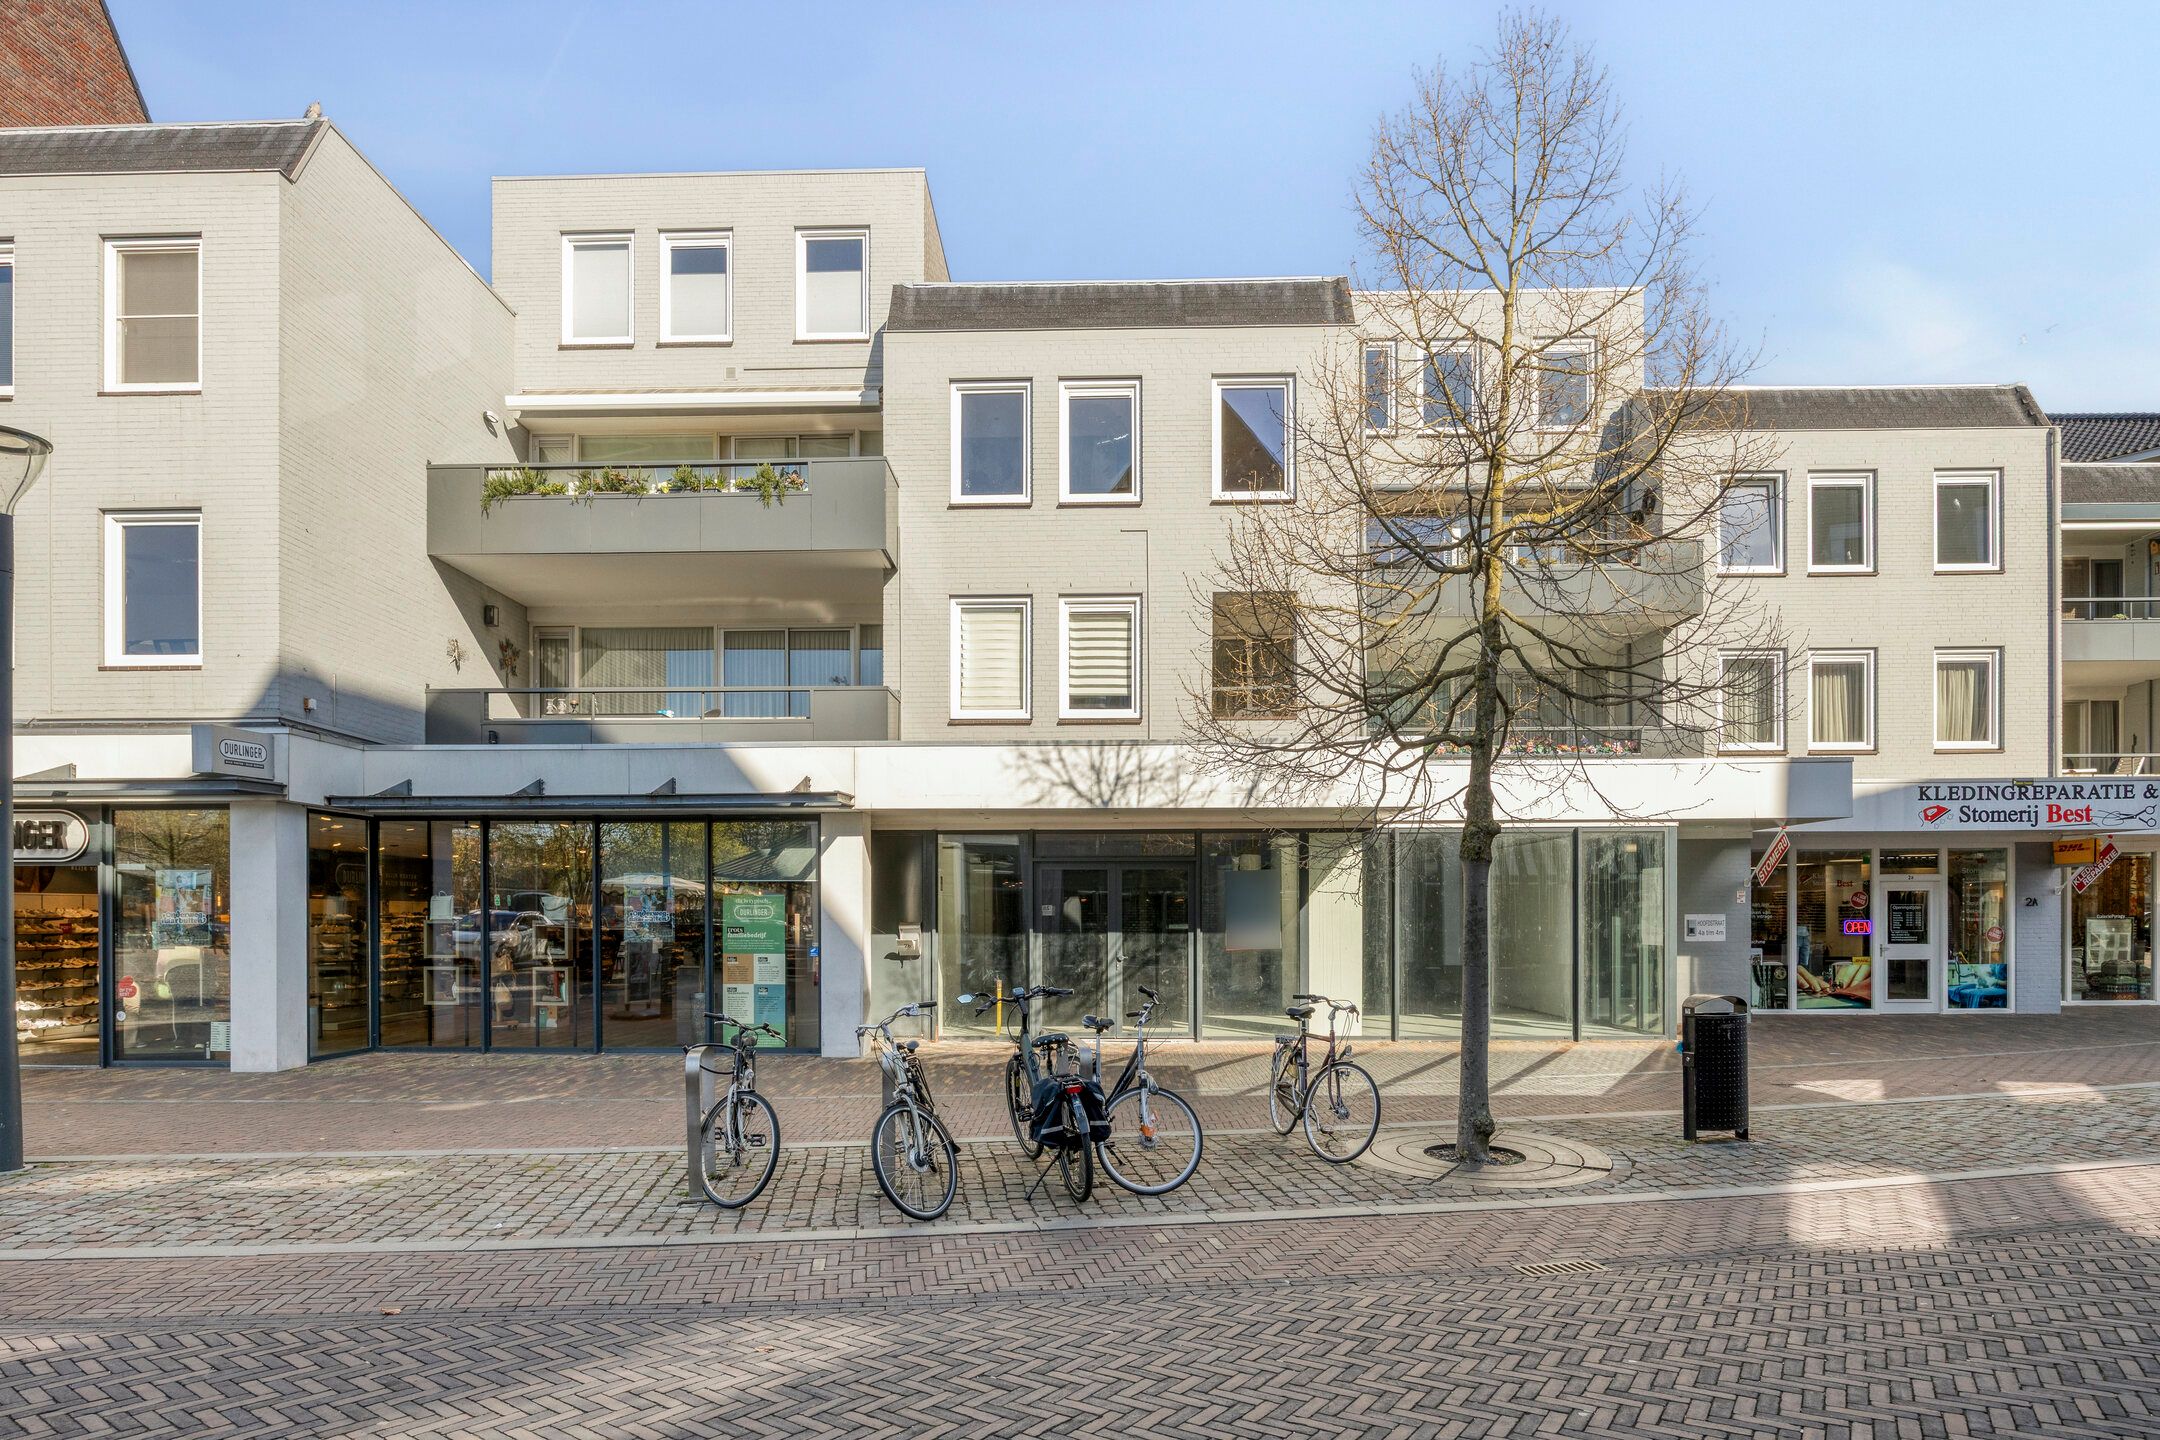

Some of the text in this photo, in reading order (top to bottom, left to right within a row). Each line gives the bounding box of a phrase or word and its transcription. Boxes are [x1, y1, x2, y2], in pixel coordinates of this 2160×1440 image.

[224, 742, 263, 759] DURLINGER
[1918, 783, 2159, 801] KLEDINGREPARATIE &
[1958, 804, 2093, 828] Stomerij Best
[2058, 843, 2084, 853] DHL
[1758, 836, 1788, 882] STOMERIJ
[2082, 848, 2118, 886] REPARATIE
[2025, 897, 2039, 907] 2A
[1845, 921, 1870, 933] OPEN
